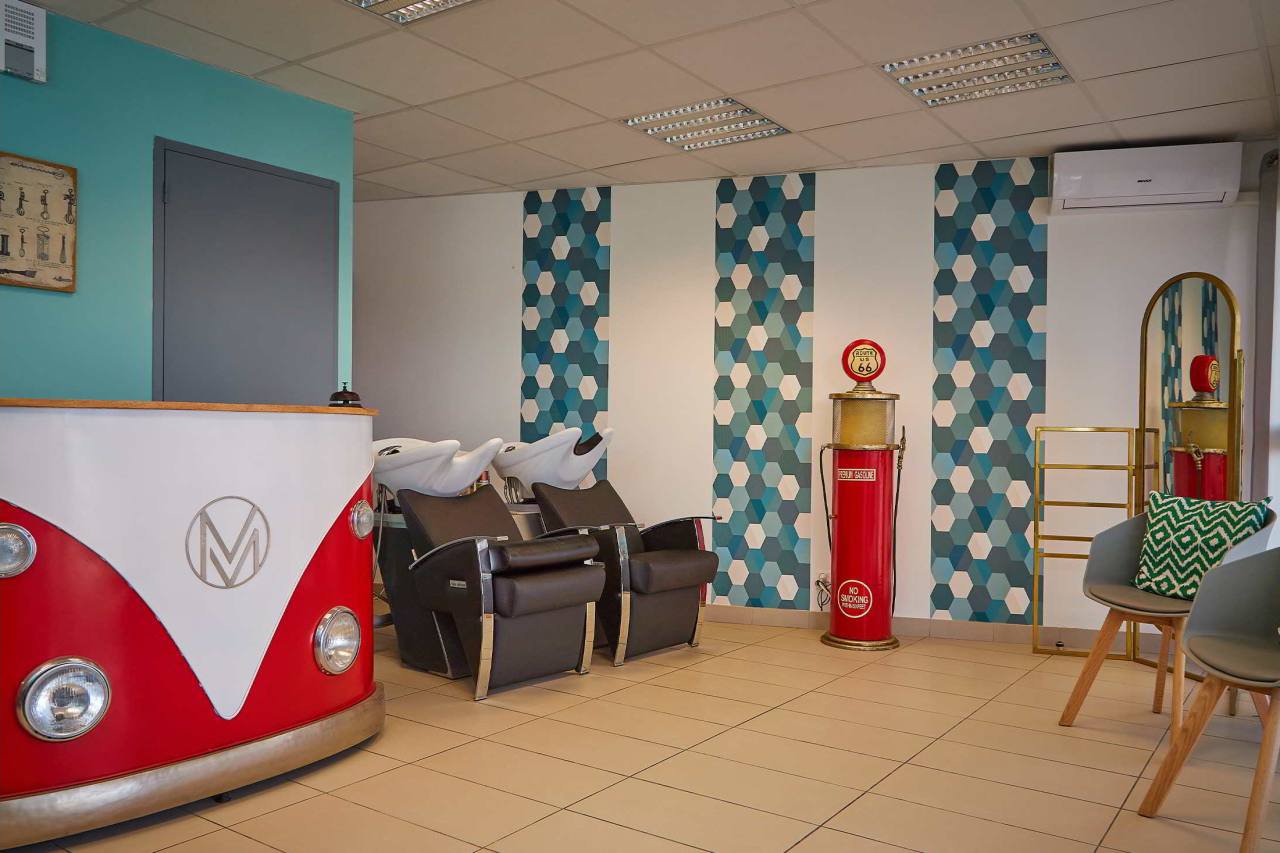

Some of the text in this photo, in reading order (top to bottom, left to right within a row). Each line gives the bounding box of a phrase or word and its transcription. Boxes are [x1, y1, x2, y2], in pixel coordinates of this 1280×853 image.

[858, 362, 872, 372] 66
[849, 587, 858, 595] NO
[841, 594, 868, 603] SMOKING
